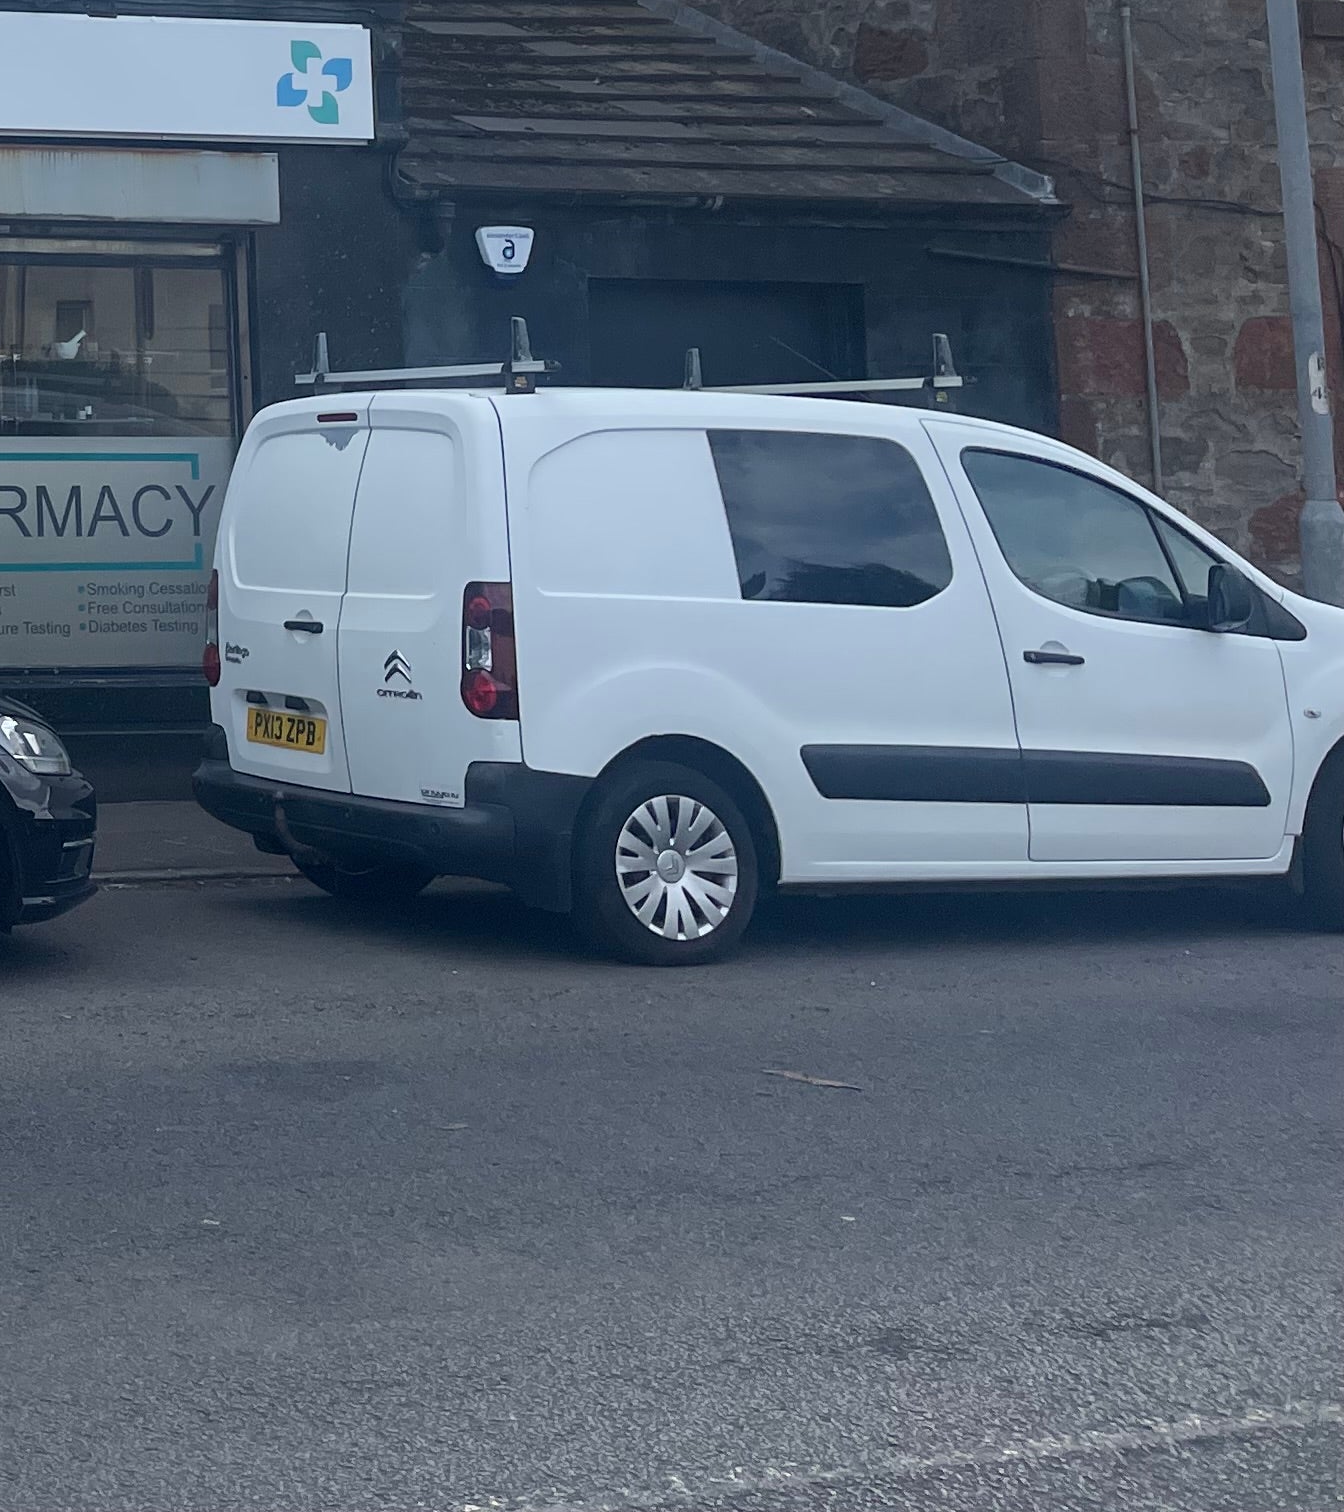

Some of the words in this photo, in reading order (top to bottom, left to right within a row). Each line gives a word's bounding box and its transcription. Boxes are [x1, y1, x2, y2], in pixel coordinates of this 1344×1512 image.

[86, 581, 145, 598] Smoking
[149, 581, 207, 595] Cessatio
[87, 601, 118, 615] Free
[23, 621, 71, 638] Testing
[88, 619, 148, 634] Diabetes
[152, 618, 199, 635] Testing
